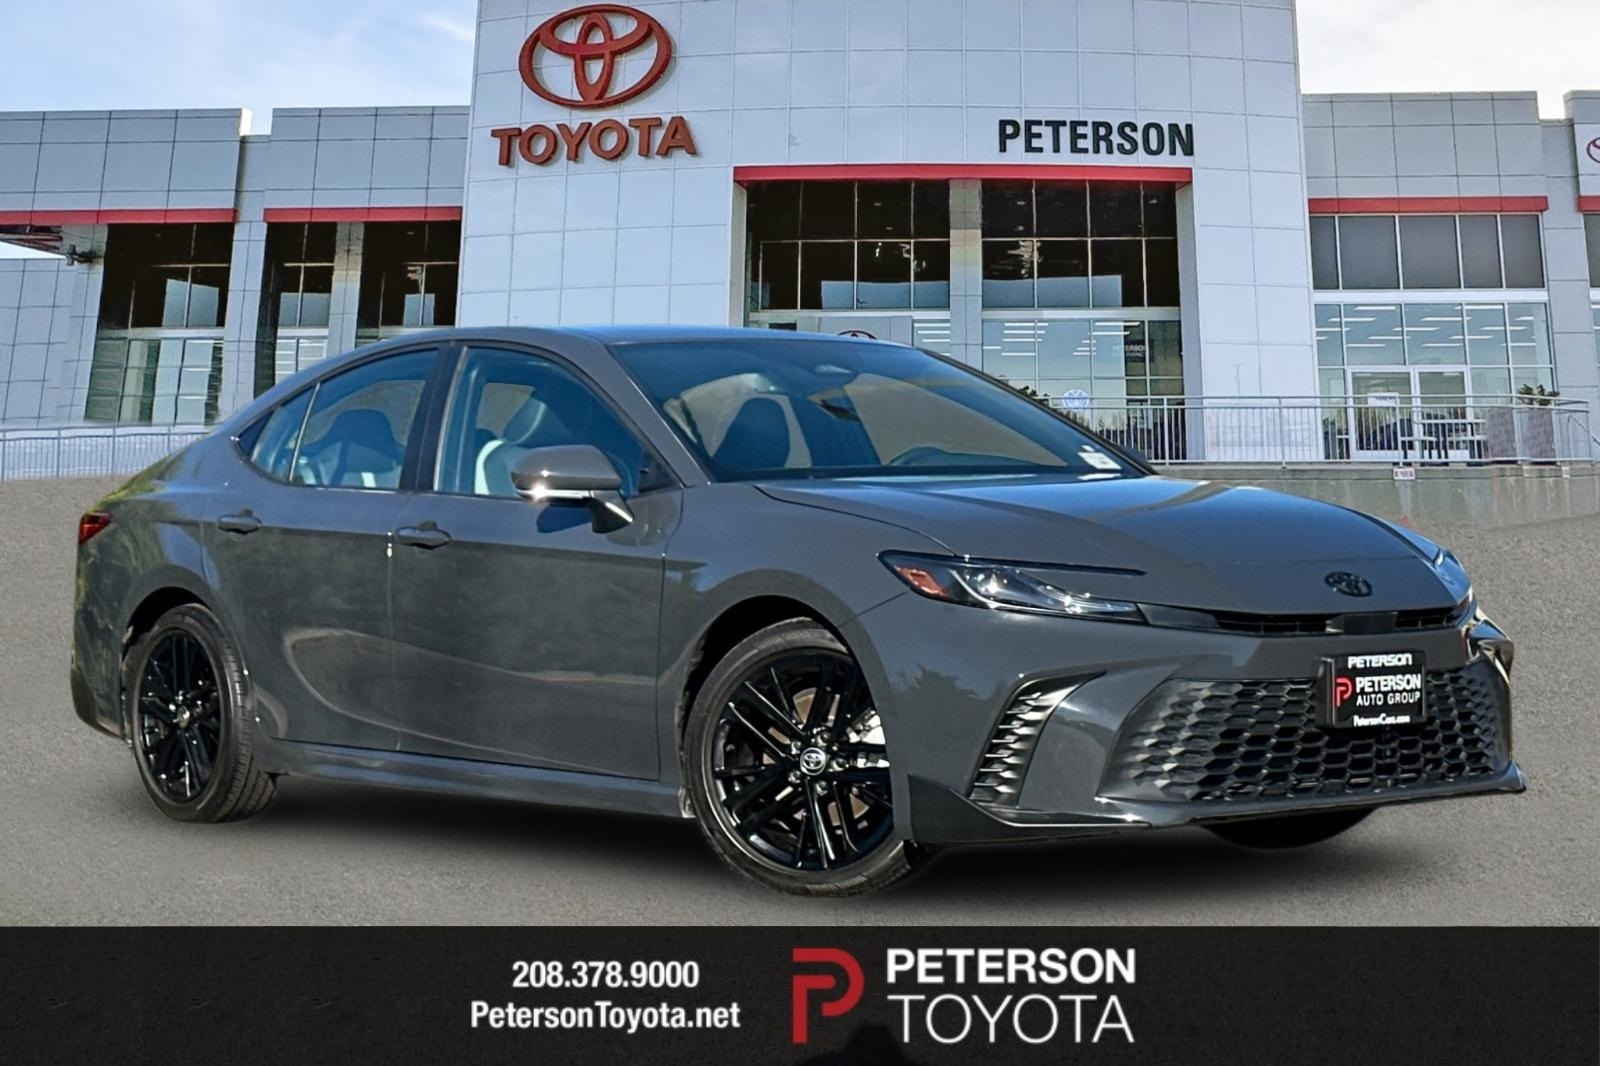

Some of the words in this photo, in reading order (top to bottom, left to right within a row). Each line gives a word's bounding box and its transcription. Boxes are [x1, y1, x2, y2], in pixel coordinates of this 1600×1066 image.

[492, 116, 697, 165] TOYOTA
[999, 119, 1195, 156] PETERSON
[1355, 673, 1421, 693] PETERSON
[1356, 694, 1384, 706] AUTO
[1387, 691, 1421, 704] GROUP
